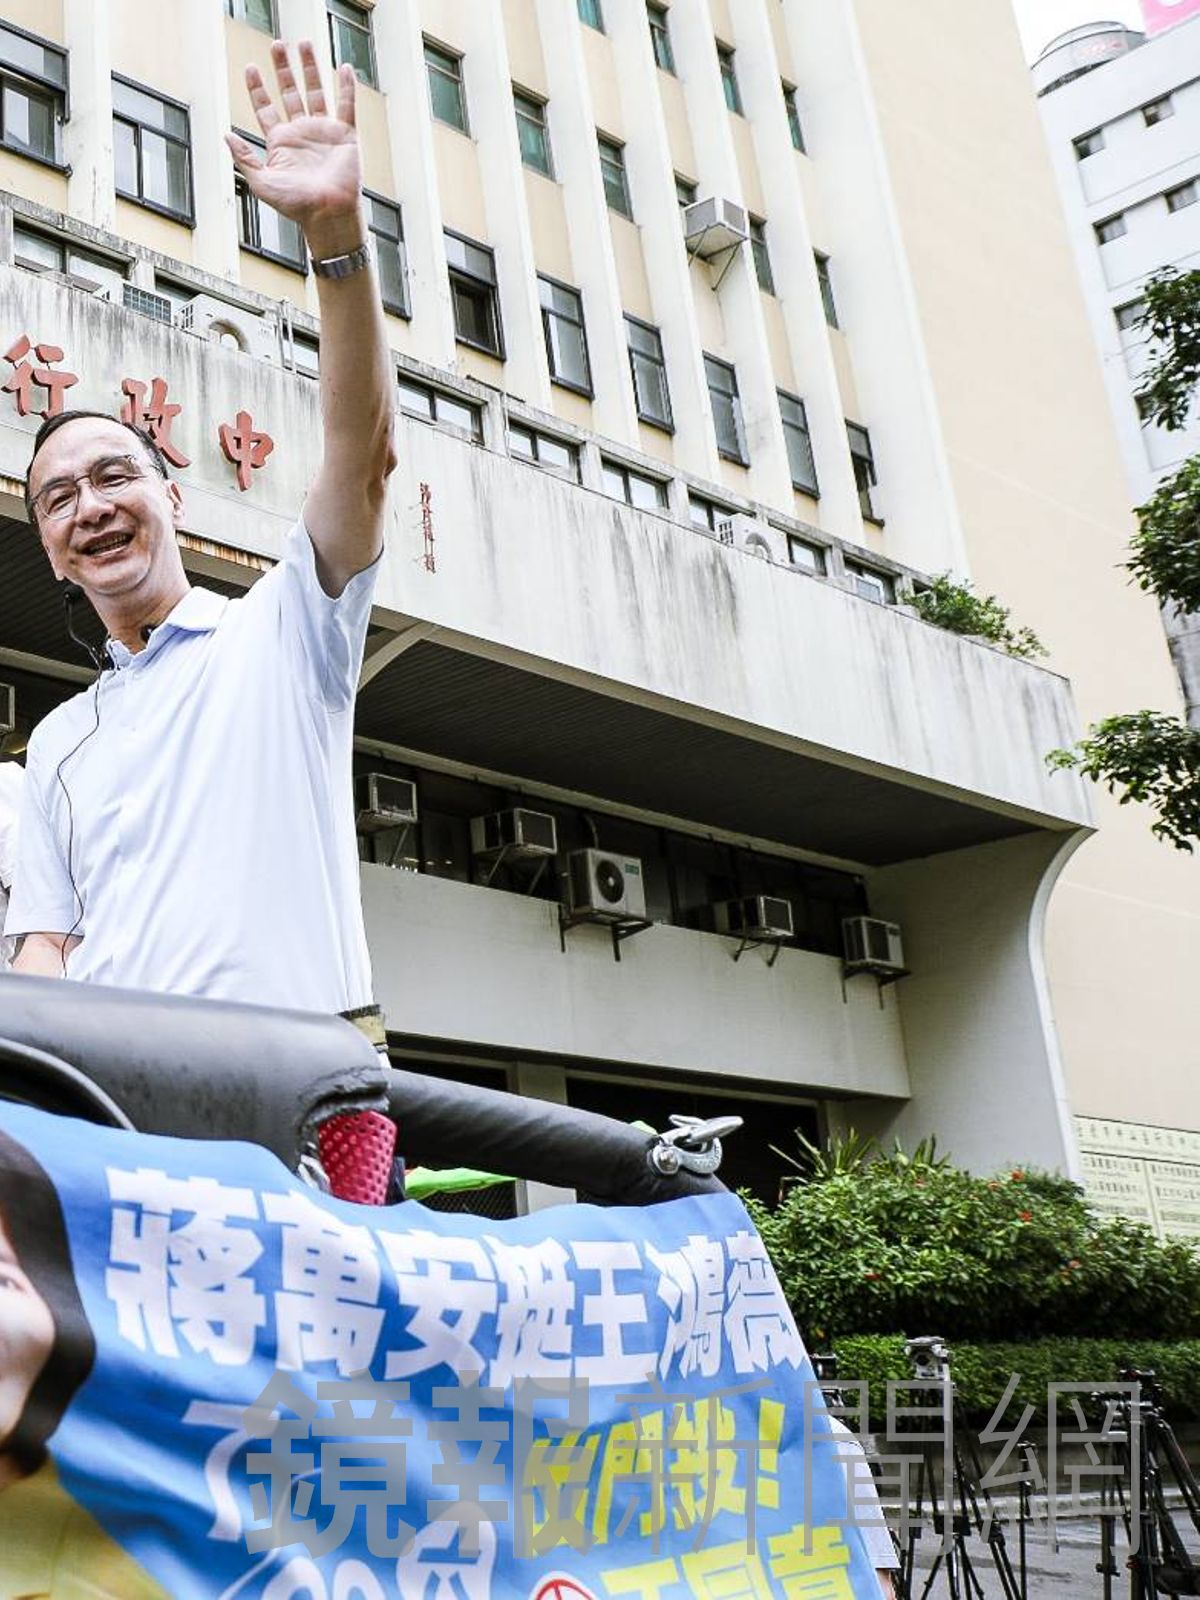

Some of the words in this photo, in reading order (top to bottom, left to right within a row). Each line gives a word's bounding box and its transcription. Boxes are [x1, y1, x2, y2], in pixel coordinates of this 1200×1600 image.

[103, 1164, 808, 1391] 蔣萬安挺王鴻薇
